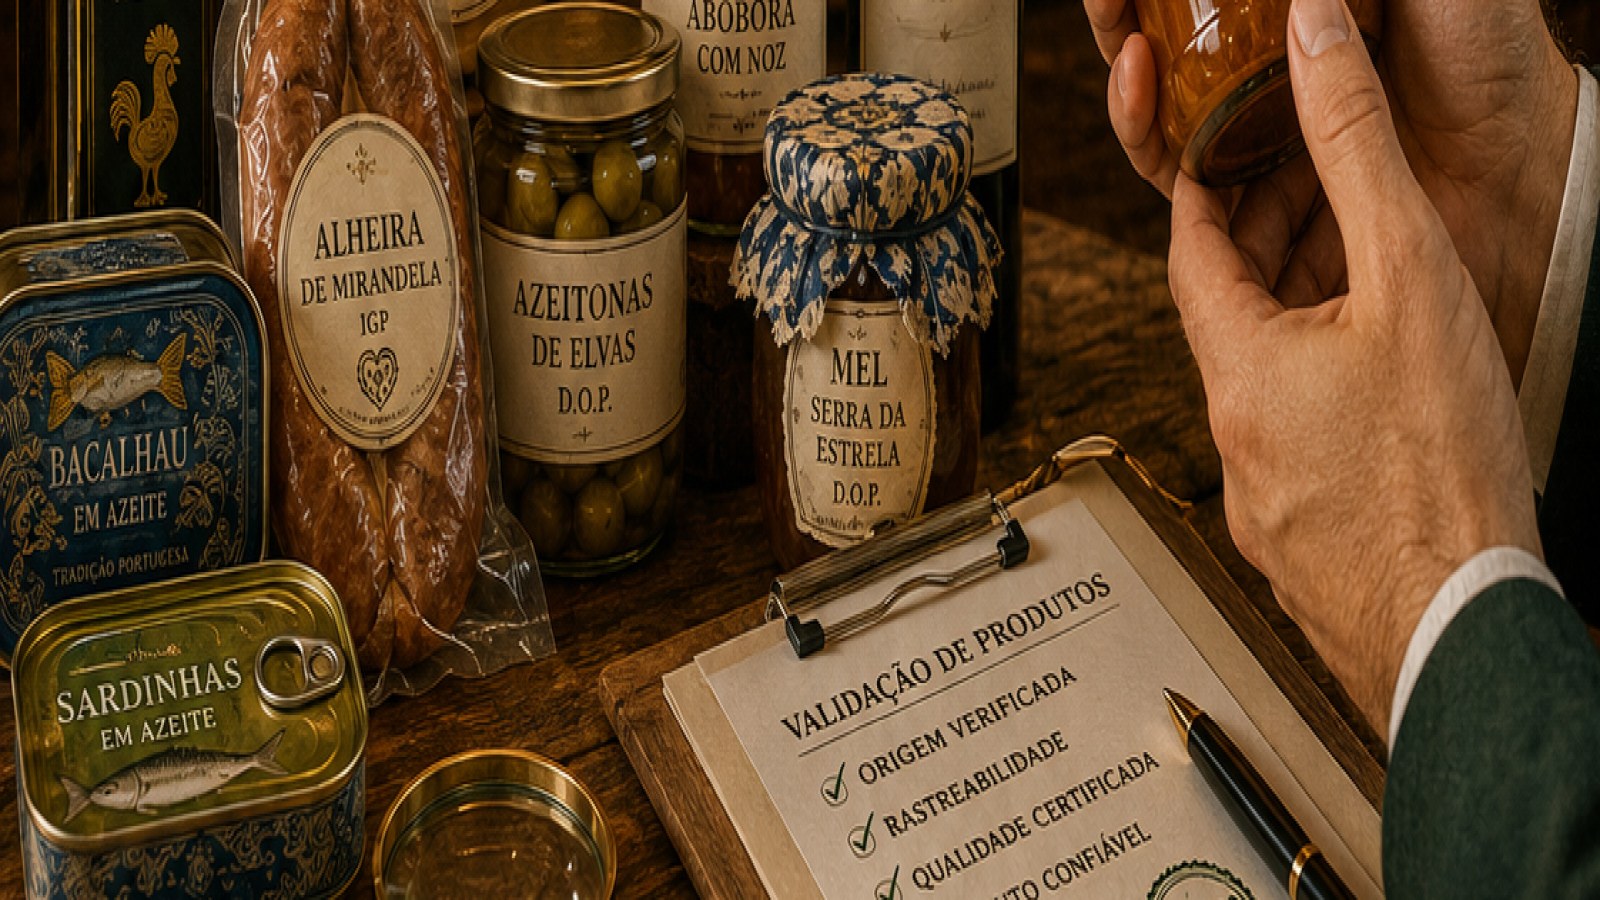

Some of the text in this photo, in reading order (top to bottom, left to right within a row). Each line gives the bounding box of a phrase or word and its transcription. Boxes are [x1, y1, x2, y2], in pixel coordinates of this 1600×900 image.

[697, 41, 786, 75] COM NOZ
[314, 210, 424, 260] ALHEIRA
[300, 261, 442, 306] DE MIRANDELA
[512, 272, 653, 323] AZEITONAS
[360, 311, 389, 336] IGP
[531, 328, 636, 369] DE ELVAS
[829, 347, 888, 388] MEL
[557, 386, 613, 415] D.O.P.
[810, 395, 906, 430] SERRA DA
[49, 426, 188, 489] BACALHAU
[816, 434, 901, 468] ESTRELA
[73, 490, 168, 534] EM AZEITE
[832, 480, 882, 506] D.O.P.
[780, 571, 1112, 741] VALIDAÇÃO DE PRODUTOS
[56, 657, 243, 724] SARDINHAS
[100, 706, 217, 751] EM AZEITE
[857, 665, 1078, 785] ORIGEM VERIFICADA
[882, 730, 1069, 839] RASTREABILIDADE
[910, 751, 1160, 893] QUALIDADE CERTIFICADA
[1041, 821, 1152, 891] CONFIÁVEL
